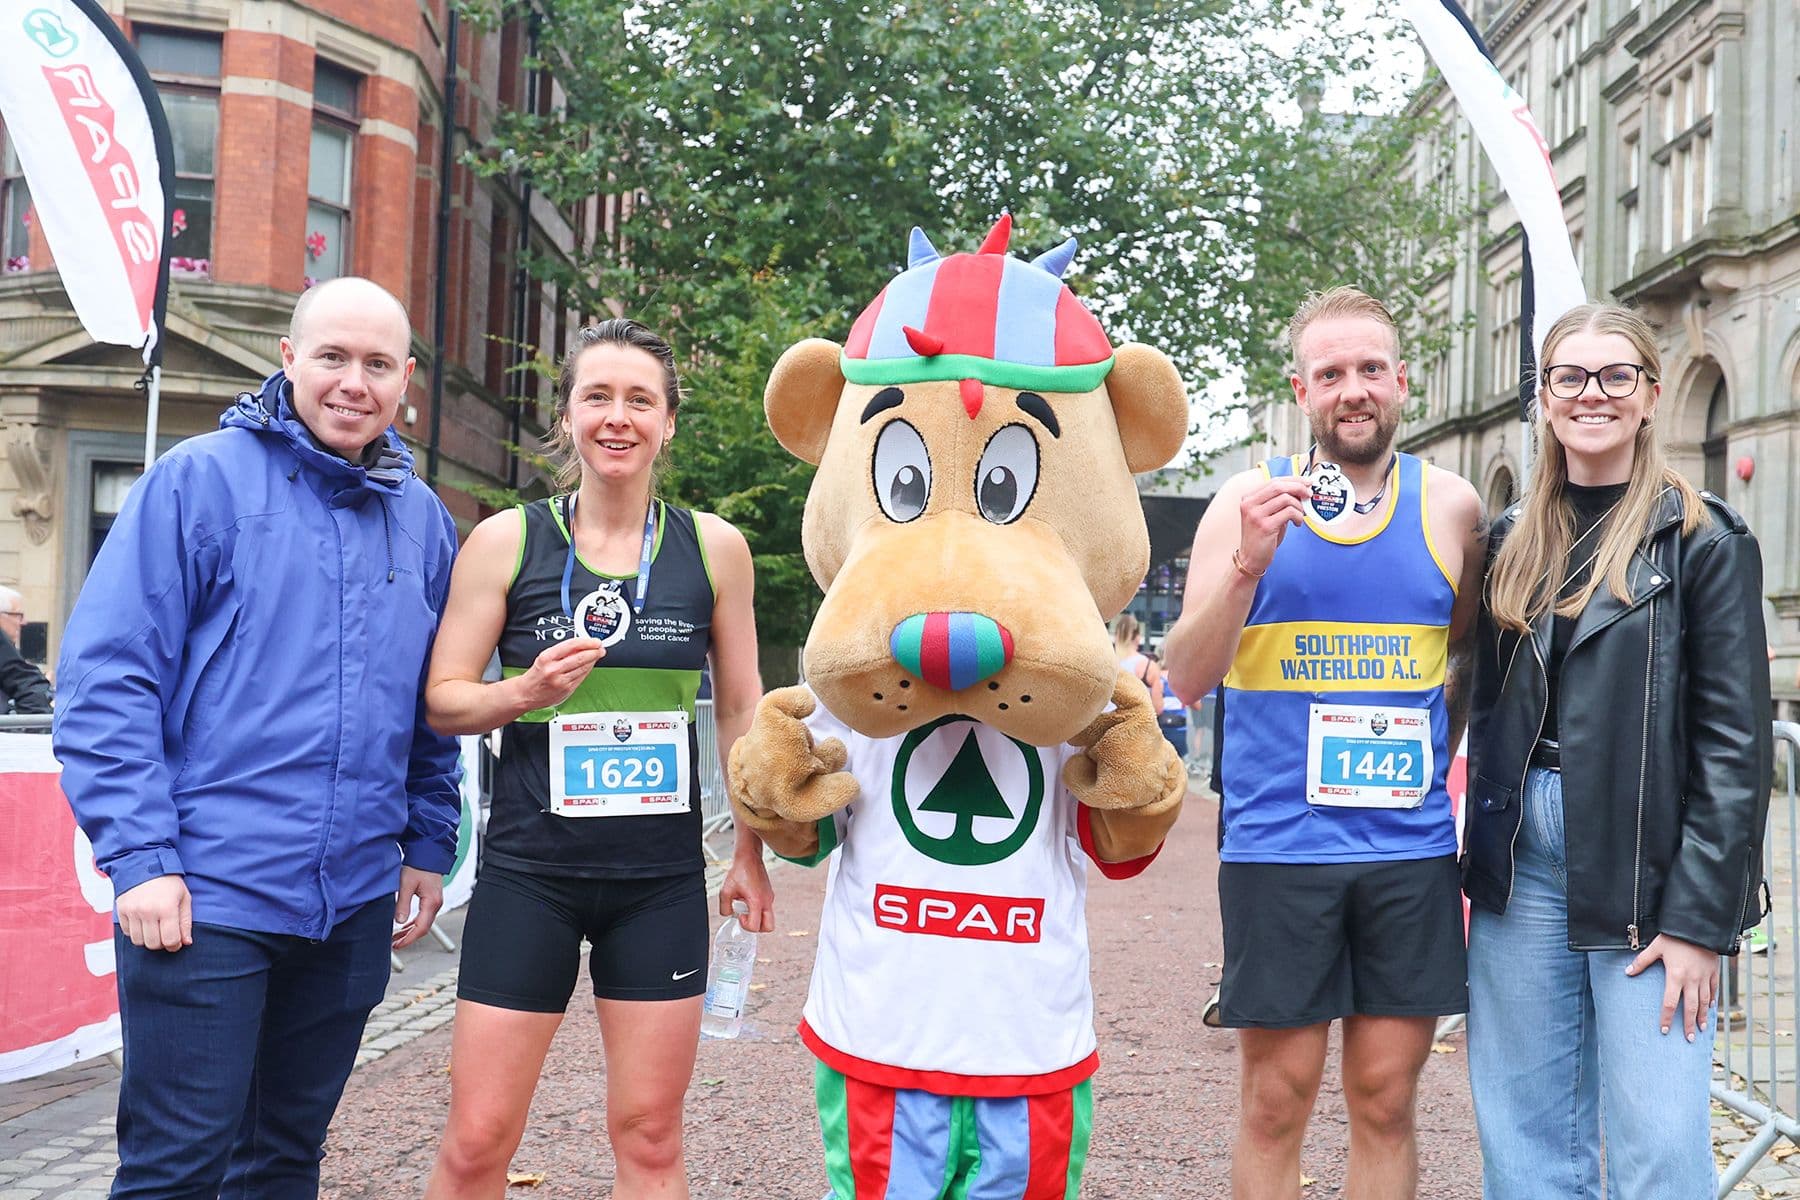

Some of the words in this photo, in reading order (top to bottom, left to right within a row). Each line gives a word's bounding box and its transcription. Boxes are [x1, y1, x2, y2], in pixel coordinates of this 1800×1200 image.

[588, 626, 611, 634] PRESTON
[664, 618, 677, 626] the
[1295, 634, 1412, 656] SOUTHPORT
[1280, 659, 1385, 680] WATERLOO
[1392, 659, 1421, 680] A.C.
[580, 757, 664, 789] 1629
[1337, 750, 1413, 782] 1442
[878, 893, 1036, 937] SPAR
